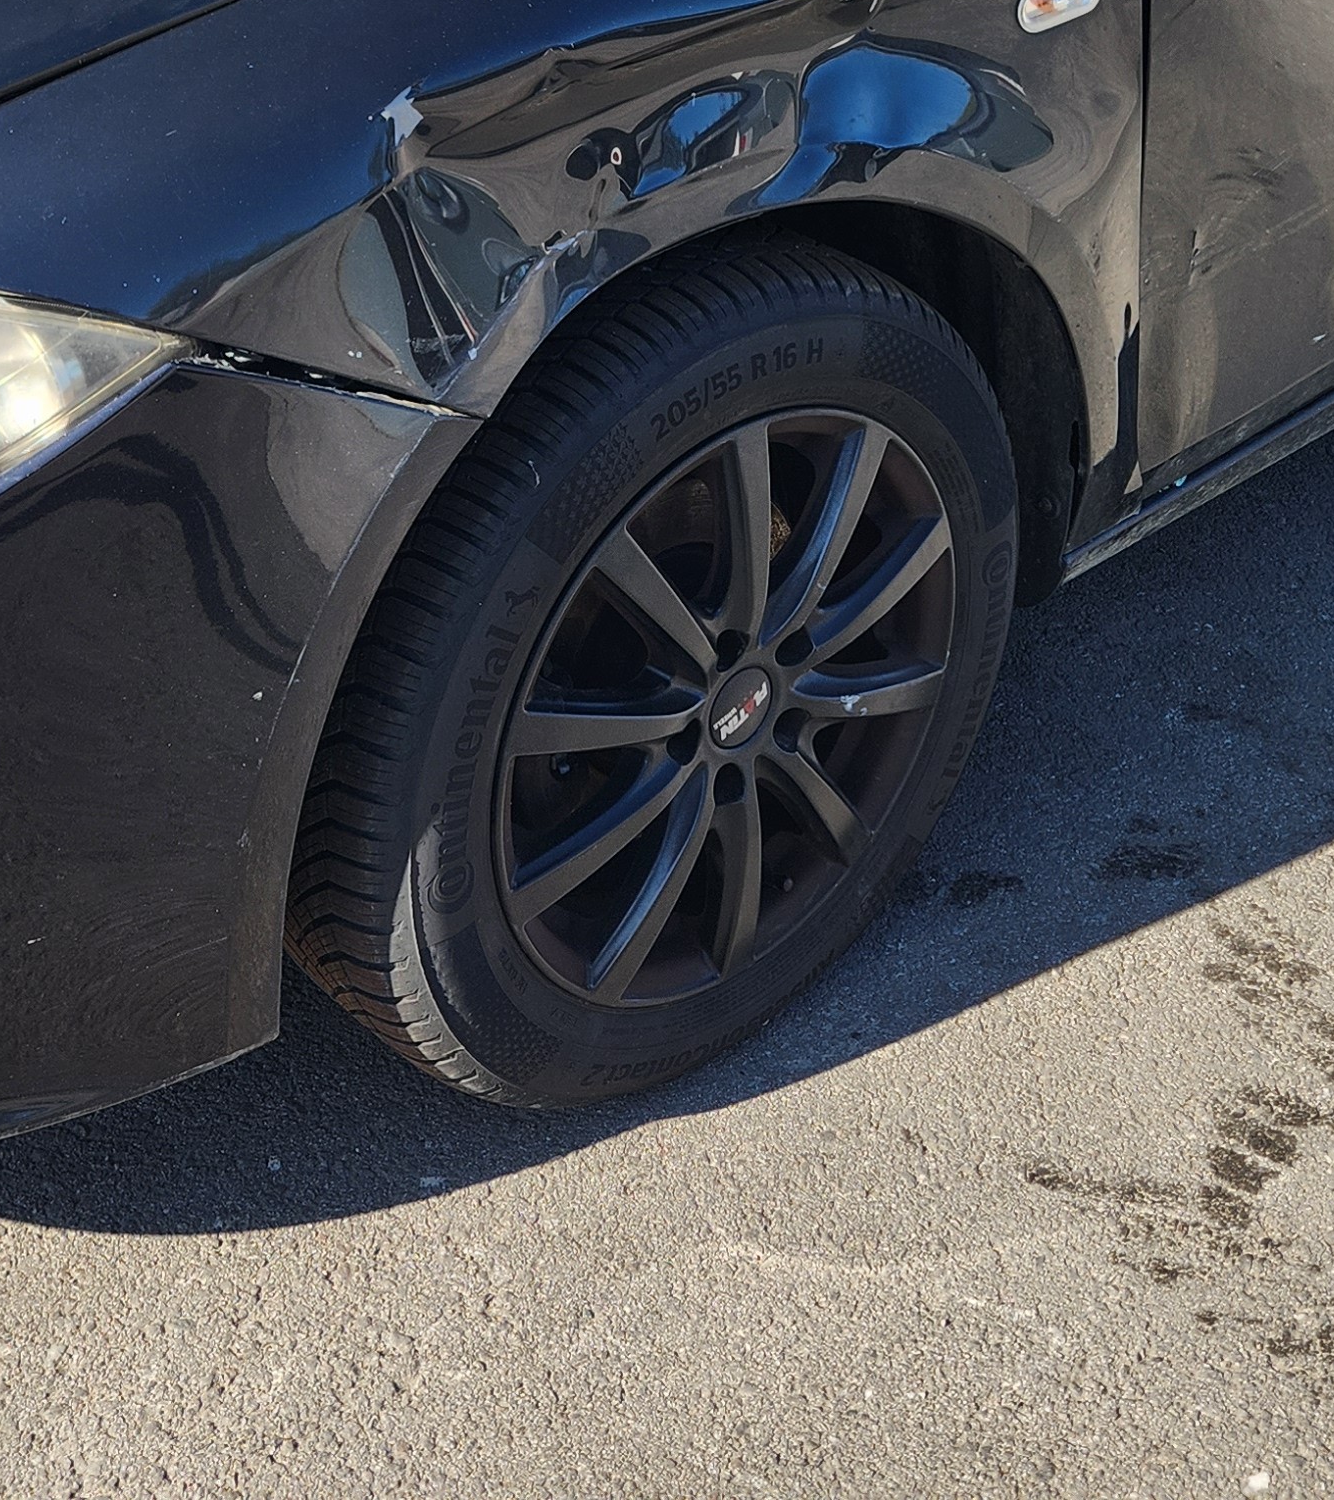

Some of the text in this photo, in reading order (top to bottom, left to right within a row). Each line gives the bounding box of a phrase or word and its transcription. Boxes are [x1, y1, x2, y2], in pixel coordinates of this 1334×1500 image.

[650, 338, 824, 442] 205/55 R 16 H
[426, 624, 524, 915] Continental
